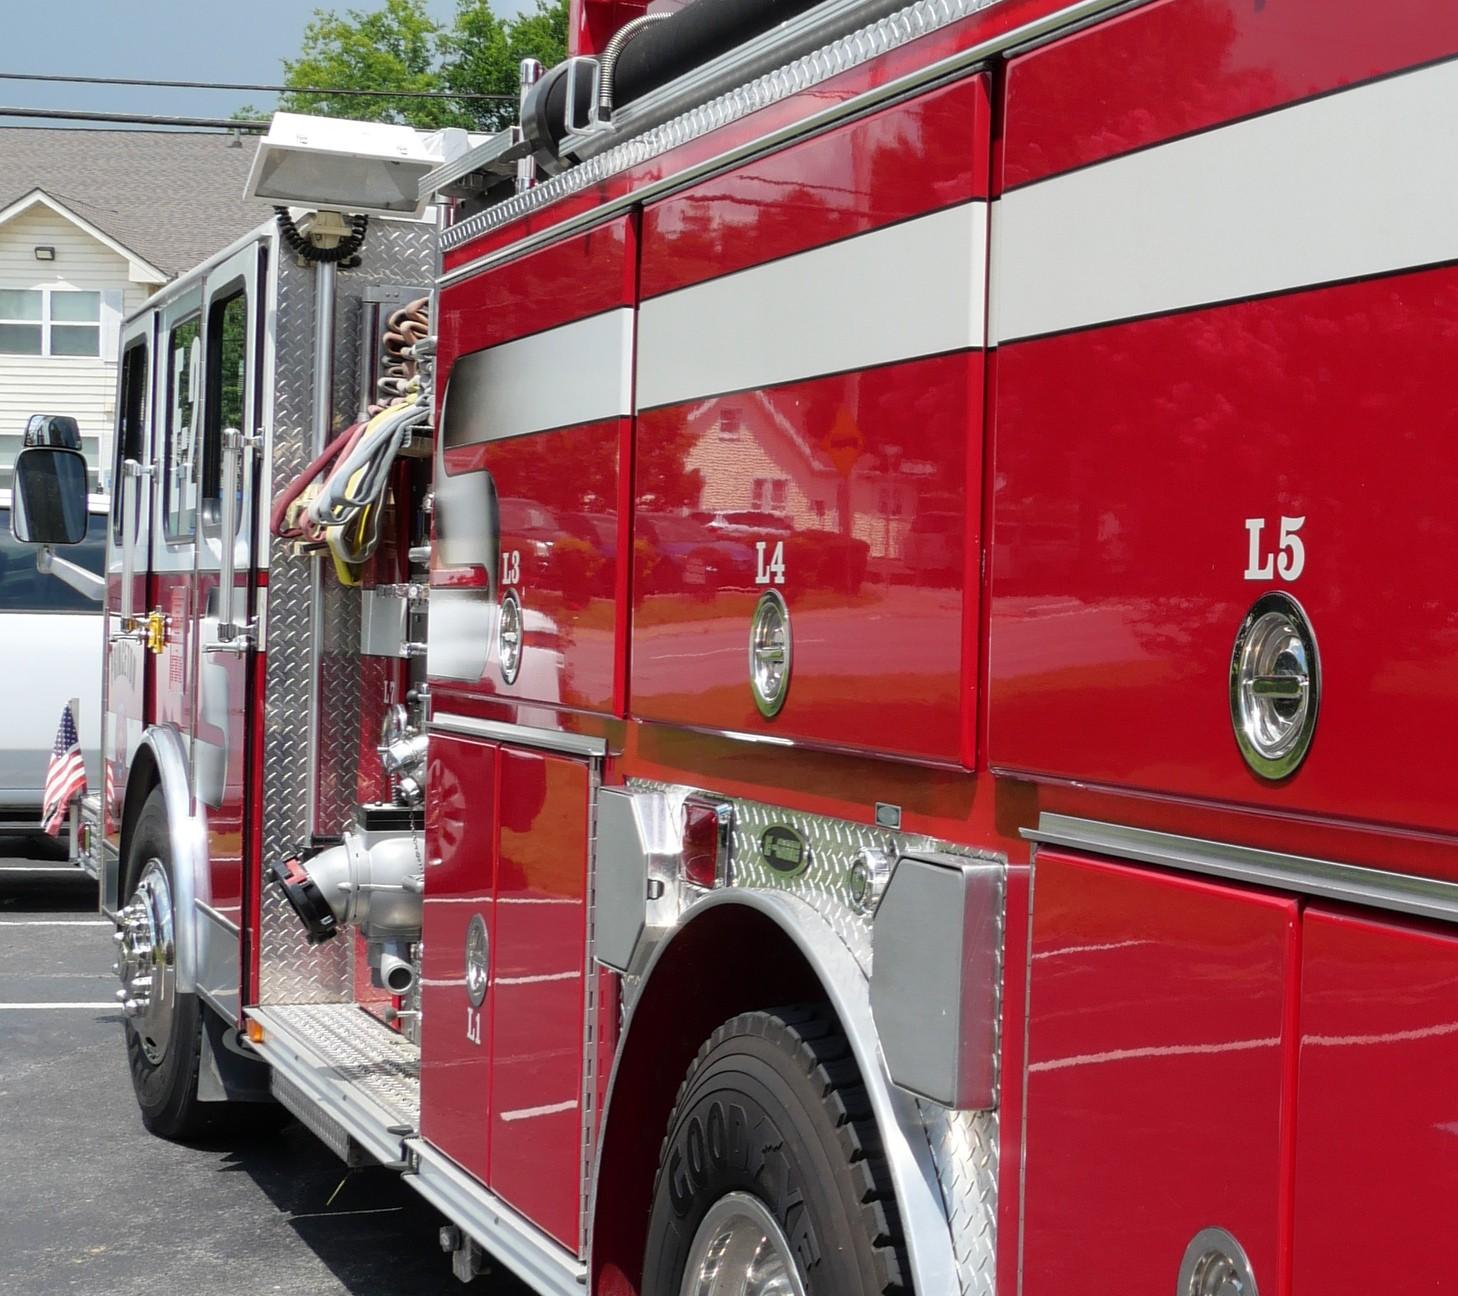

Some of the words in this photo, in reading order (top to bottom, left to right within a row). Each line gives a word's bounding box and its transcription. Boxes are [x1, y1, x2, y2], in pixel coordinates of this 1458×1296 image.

[502, 550, 521, 585] L3
[755, 541, 785, 584] L4
[1243, 515, 1306, 581] L5
[466, 1007, 481, 1045] L1
